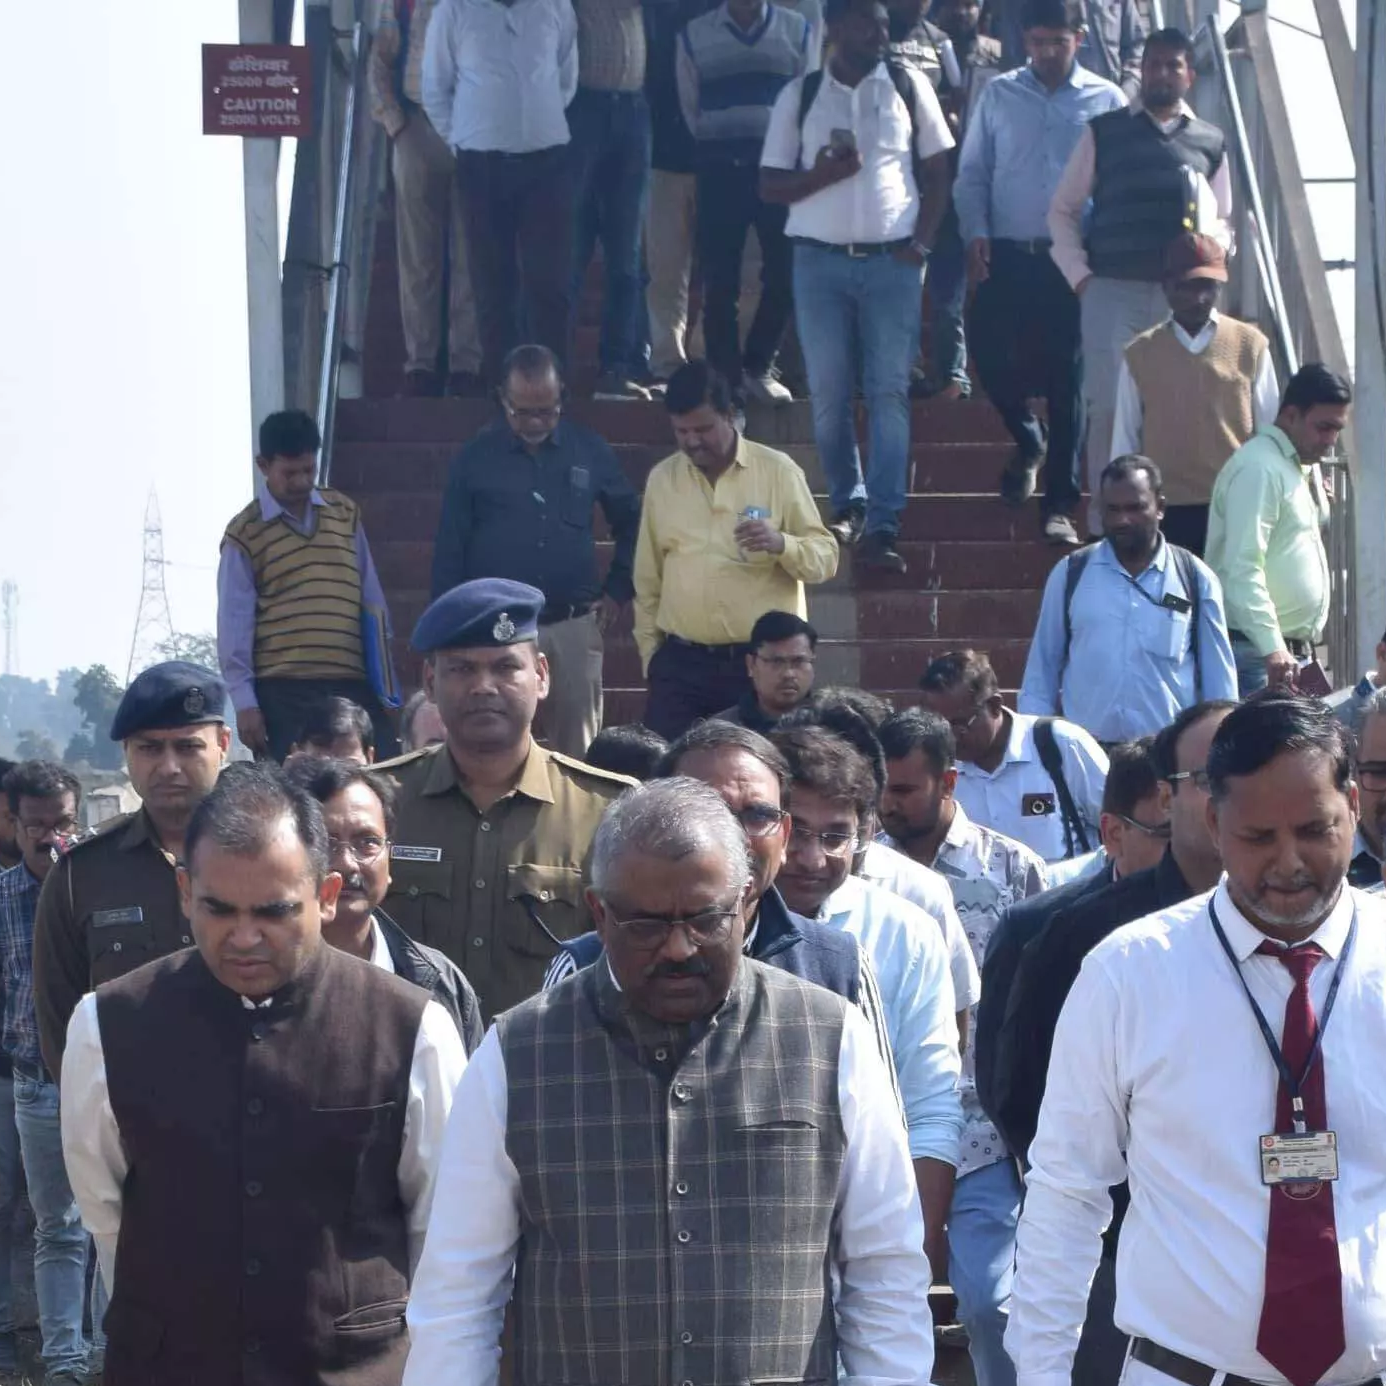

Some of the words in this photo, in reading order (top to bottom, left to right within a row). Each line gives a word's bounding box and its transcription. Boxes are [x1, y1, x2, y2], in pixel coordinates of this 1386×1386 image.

[223, 98, 297, 112] CAUTION
[219, 114, 257, 126] 25000
[260, 114, 301, 126] VOLTS
